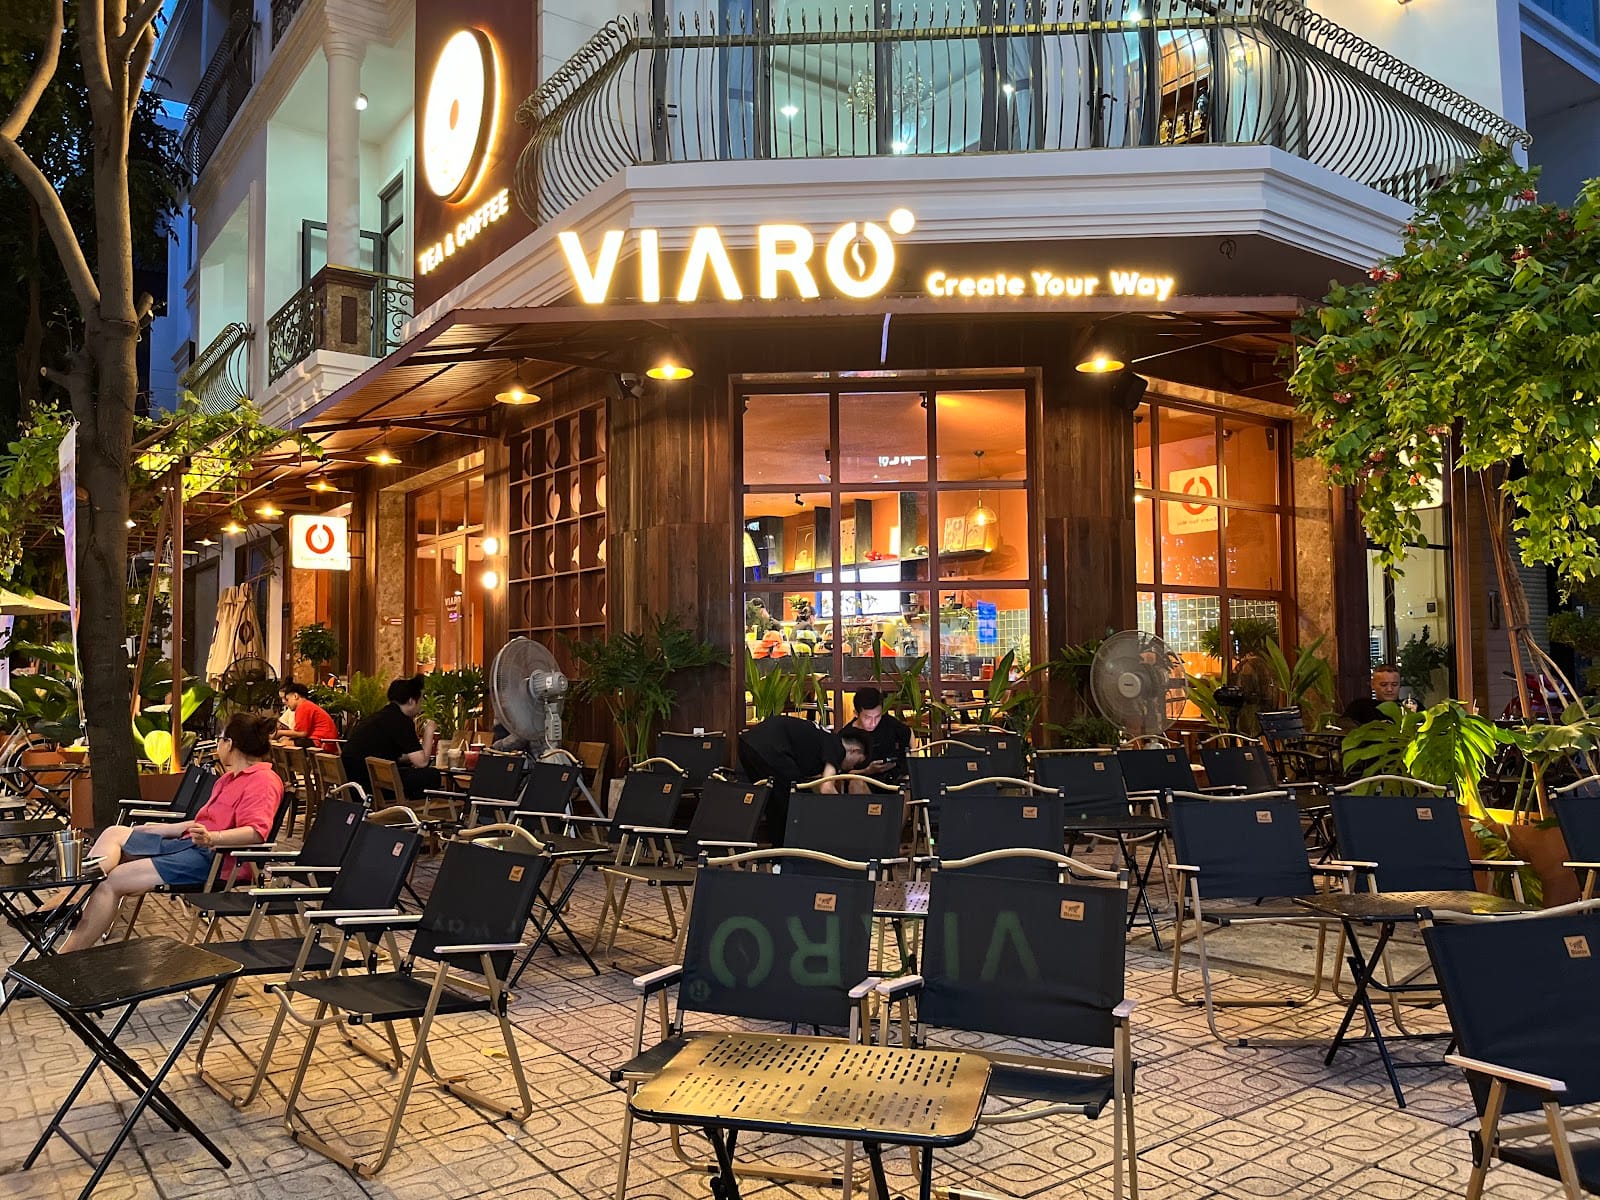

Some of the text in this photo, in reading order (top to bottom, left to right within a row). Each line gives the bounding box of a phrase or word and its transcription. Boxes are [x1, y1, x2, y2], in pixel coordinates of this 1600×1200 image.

[419, 188, 509, 275] TEA & COFFEE
[558, 221, 895, 304] VIARO
[926, 270, 1174, 301] Create Your Way
